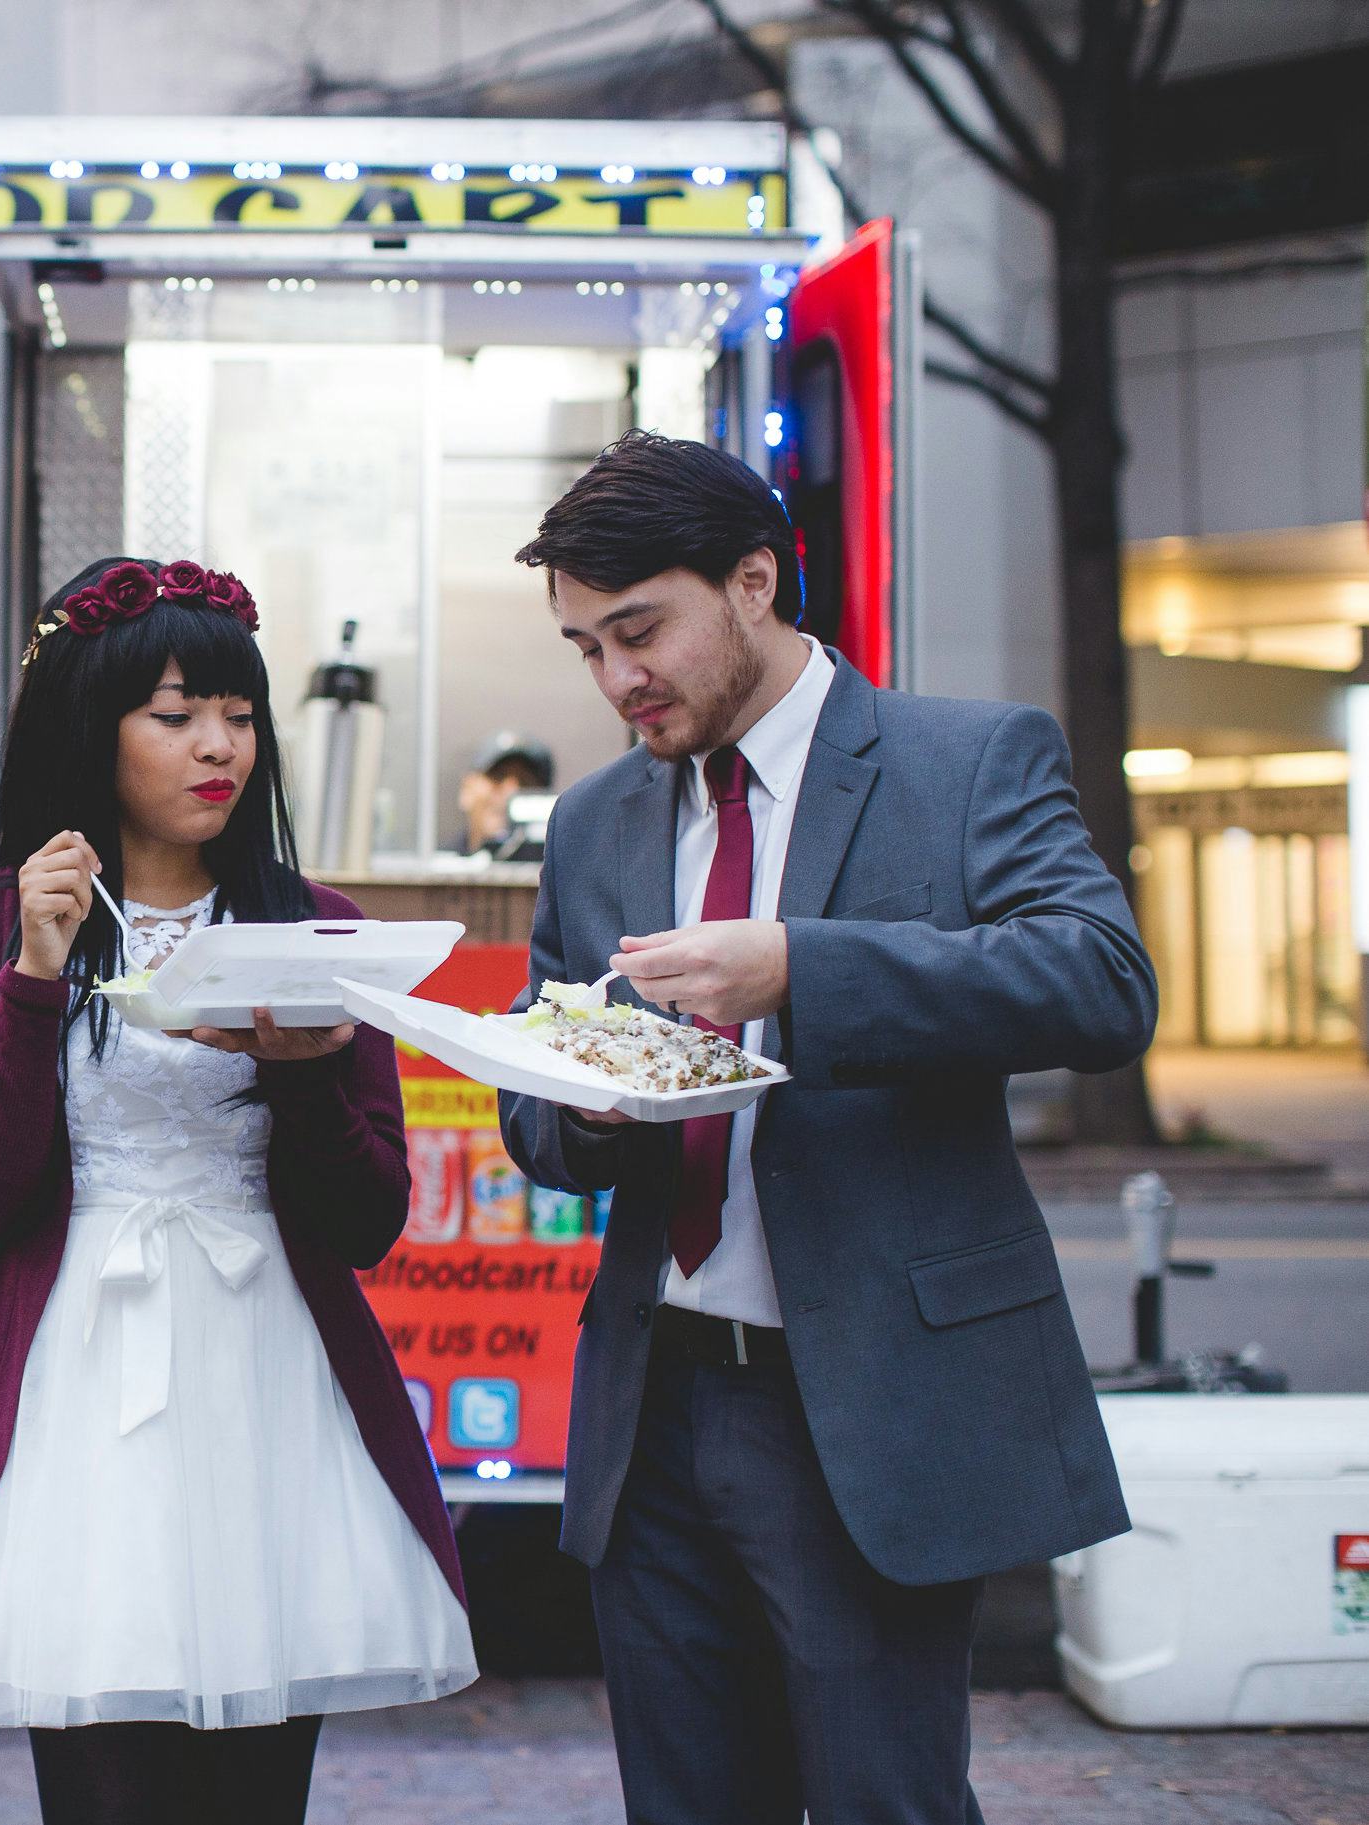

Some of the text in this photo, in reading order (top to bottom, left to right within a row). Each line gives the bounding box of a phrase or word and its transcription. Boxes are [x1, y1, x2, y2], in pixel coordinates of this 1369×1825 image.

[212, 185, 686, 227] CART
[427, 1323, 477, 1358] US
[485, 1323, 540, 1359] ON
